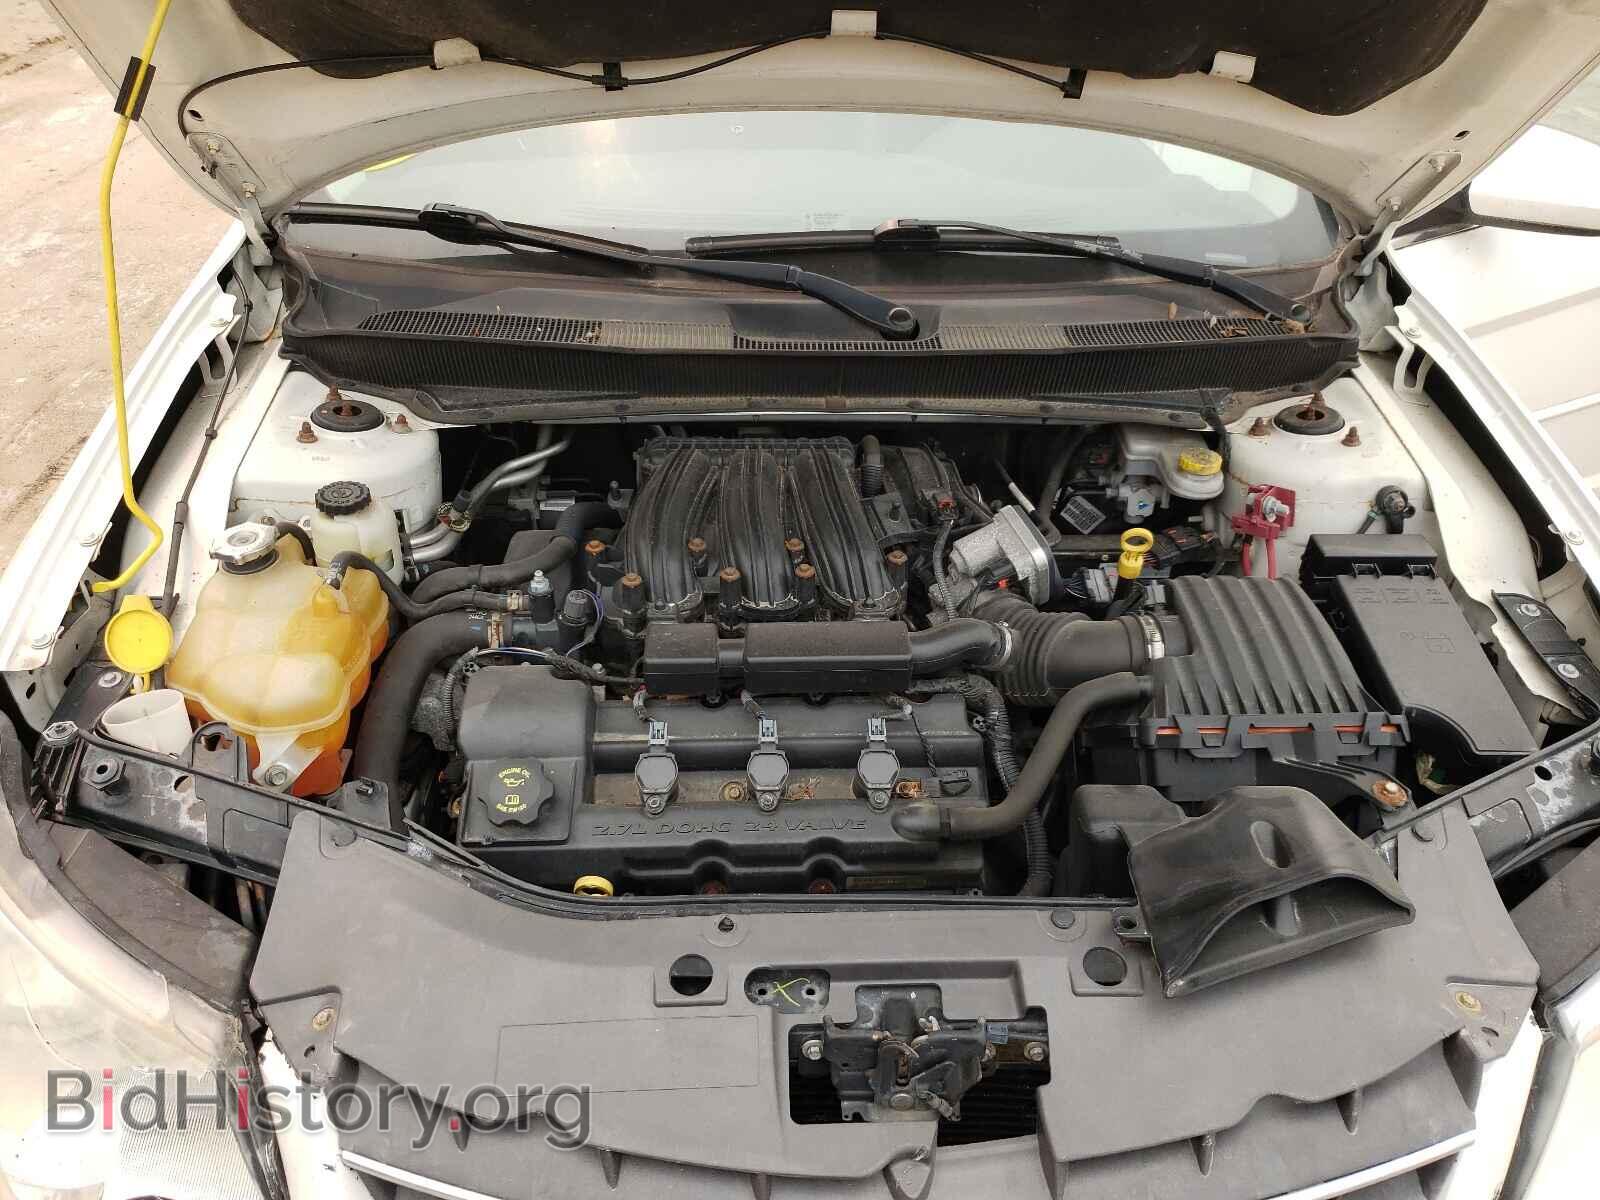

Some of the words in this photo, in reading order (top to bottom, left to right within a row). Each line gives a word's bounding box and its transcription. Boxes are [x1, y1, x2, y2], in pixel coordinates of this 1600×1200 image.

[498, 767, 522, 779] ENGINE
[591, 823, 648, 836] 2.7L
[655, 822, 733, 835] DOHC
[784, 818, 868, 832] VALVE
